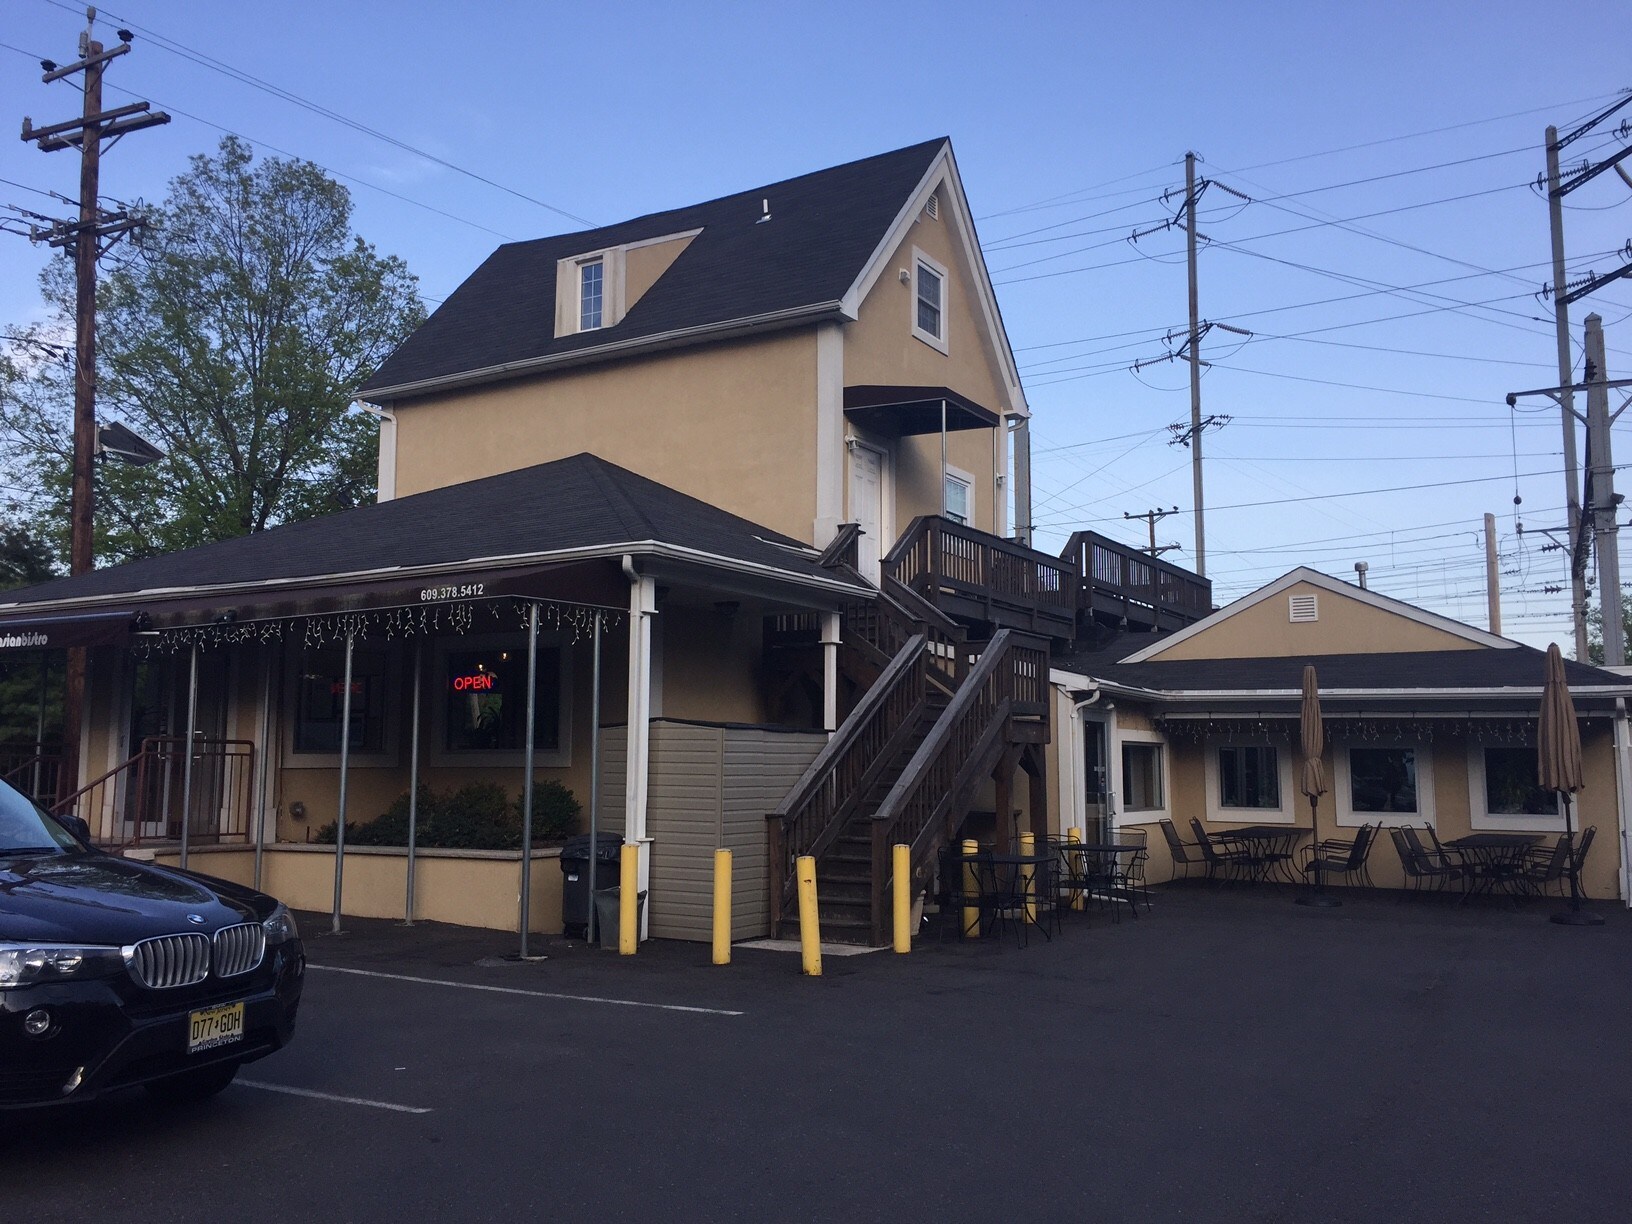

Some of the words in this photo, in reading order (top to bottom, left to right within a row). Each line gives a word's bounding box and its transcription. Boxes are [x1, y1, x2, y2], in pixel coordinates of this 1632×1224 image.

[420, 583, 484, 601] 609.378.5412
[454, 675, 491, 690] OPEN
[191, 1035, 241, 1053] PRINCETON
